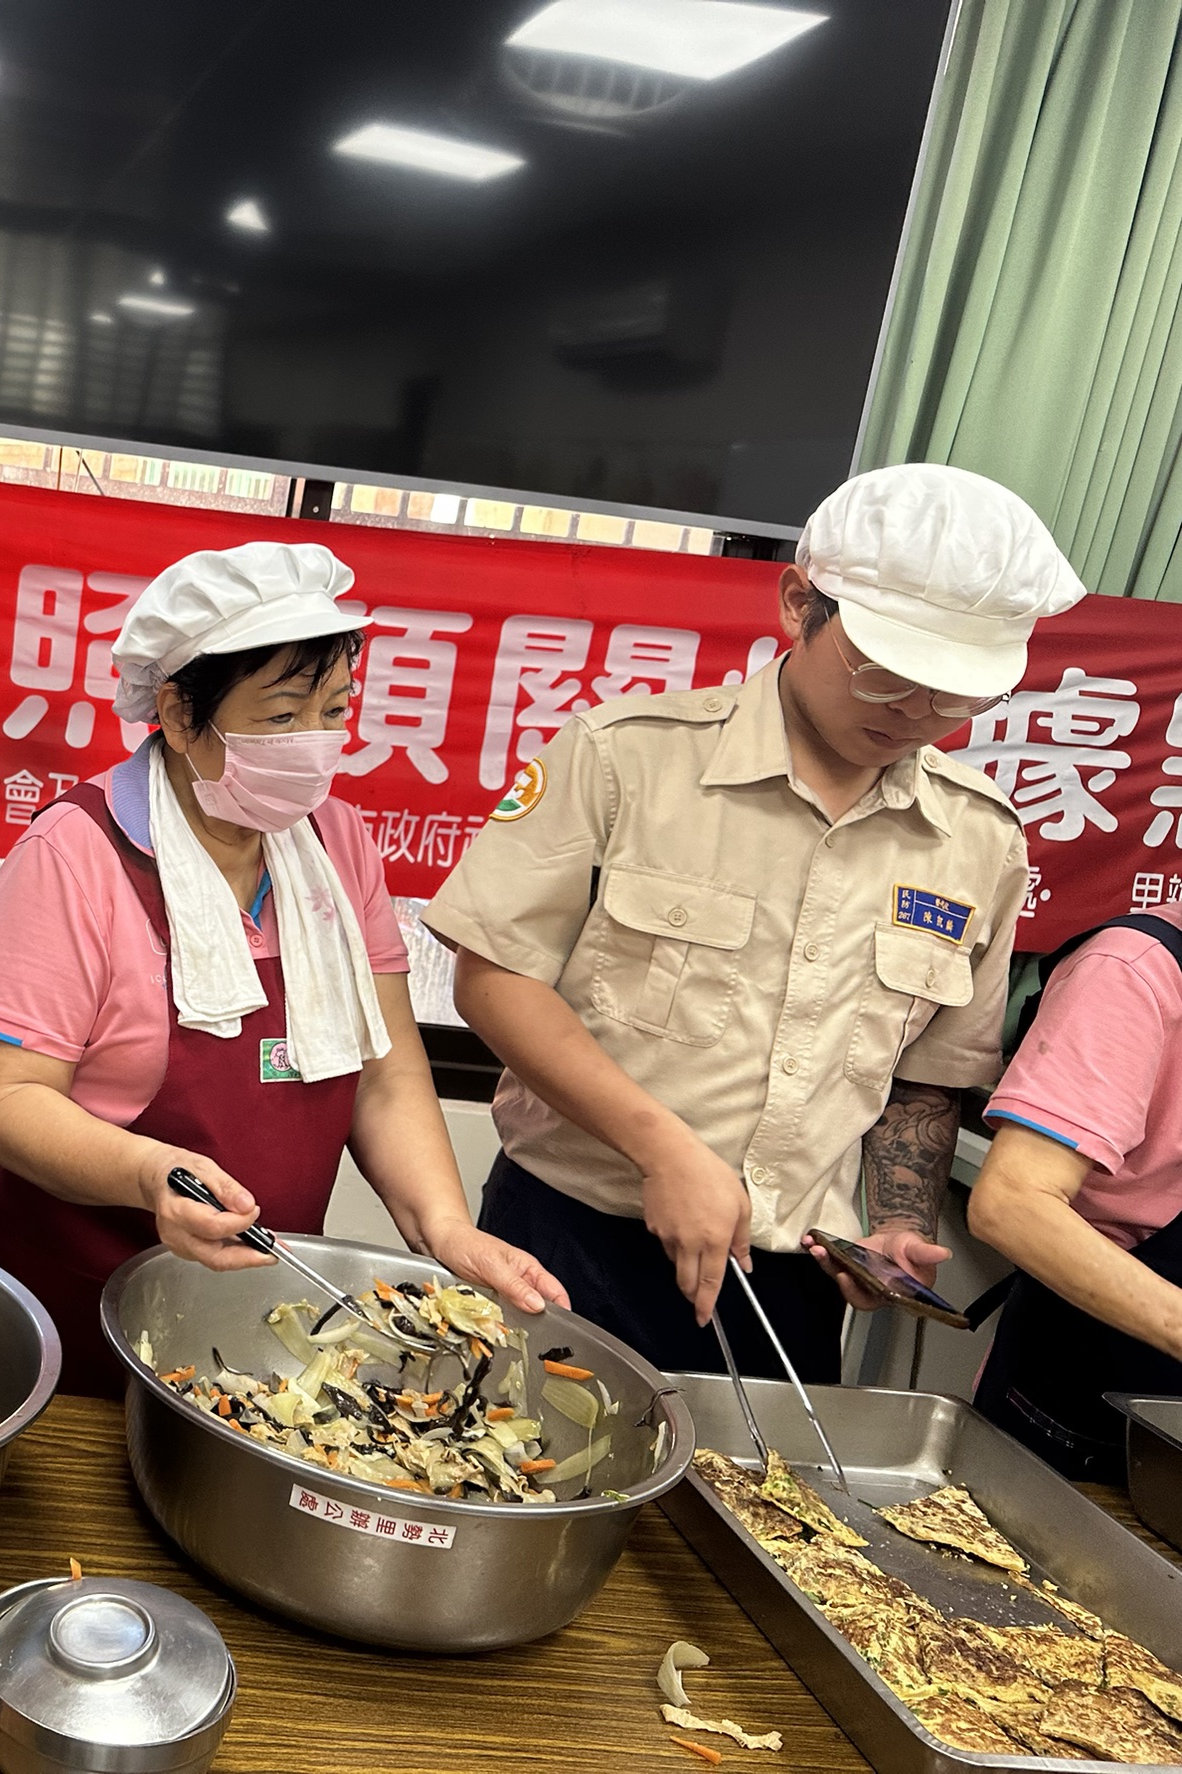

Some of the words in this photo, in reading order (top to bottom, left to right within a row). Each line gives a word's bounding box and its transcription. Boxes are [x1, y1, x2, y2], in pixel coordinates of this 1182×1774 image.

[299, 1490, 449, 1545] 北勢里辦公處
